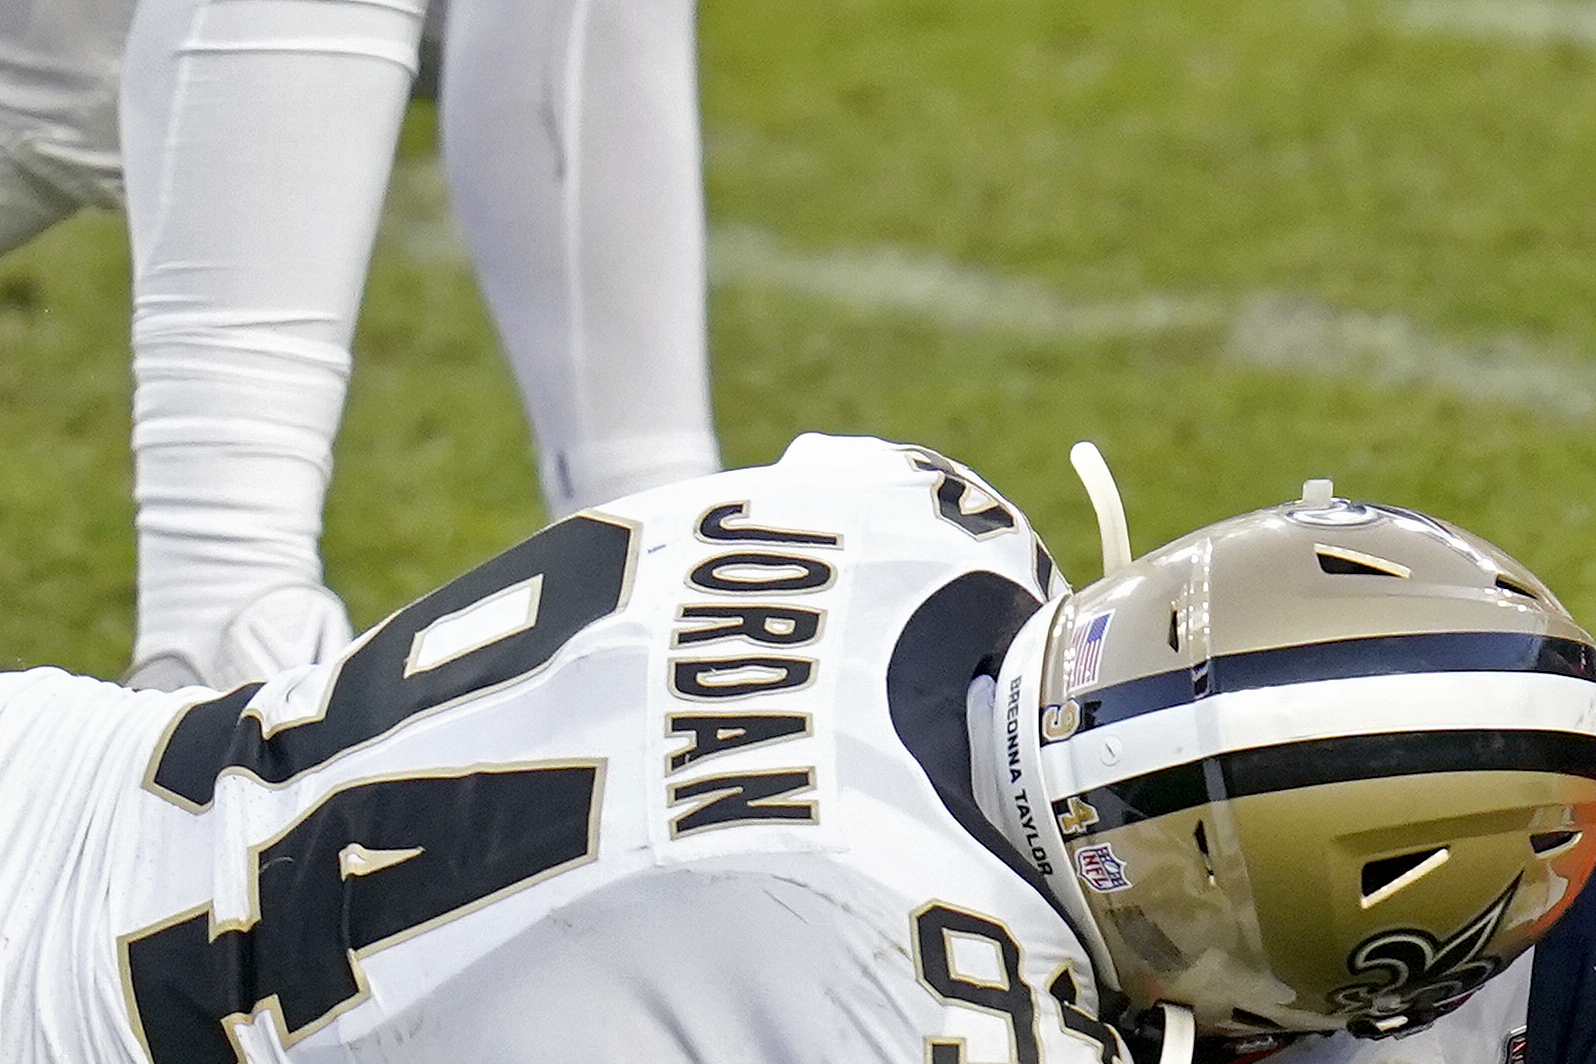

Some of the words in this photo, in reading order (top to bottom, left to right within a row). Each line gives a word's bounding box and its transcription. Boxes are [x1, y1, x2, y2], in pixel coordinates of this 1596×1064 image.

[664, 499, 845, 840] JORDAN
[1042, 699, 1081, 741] 9
[1006, 675, 1022, 784] BREONNA
[1014, 788, 1053, 877] TAYLOR
[1057, 796, 1099, 836] 4
